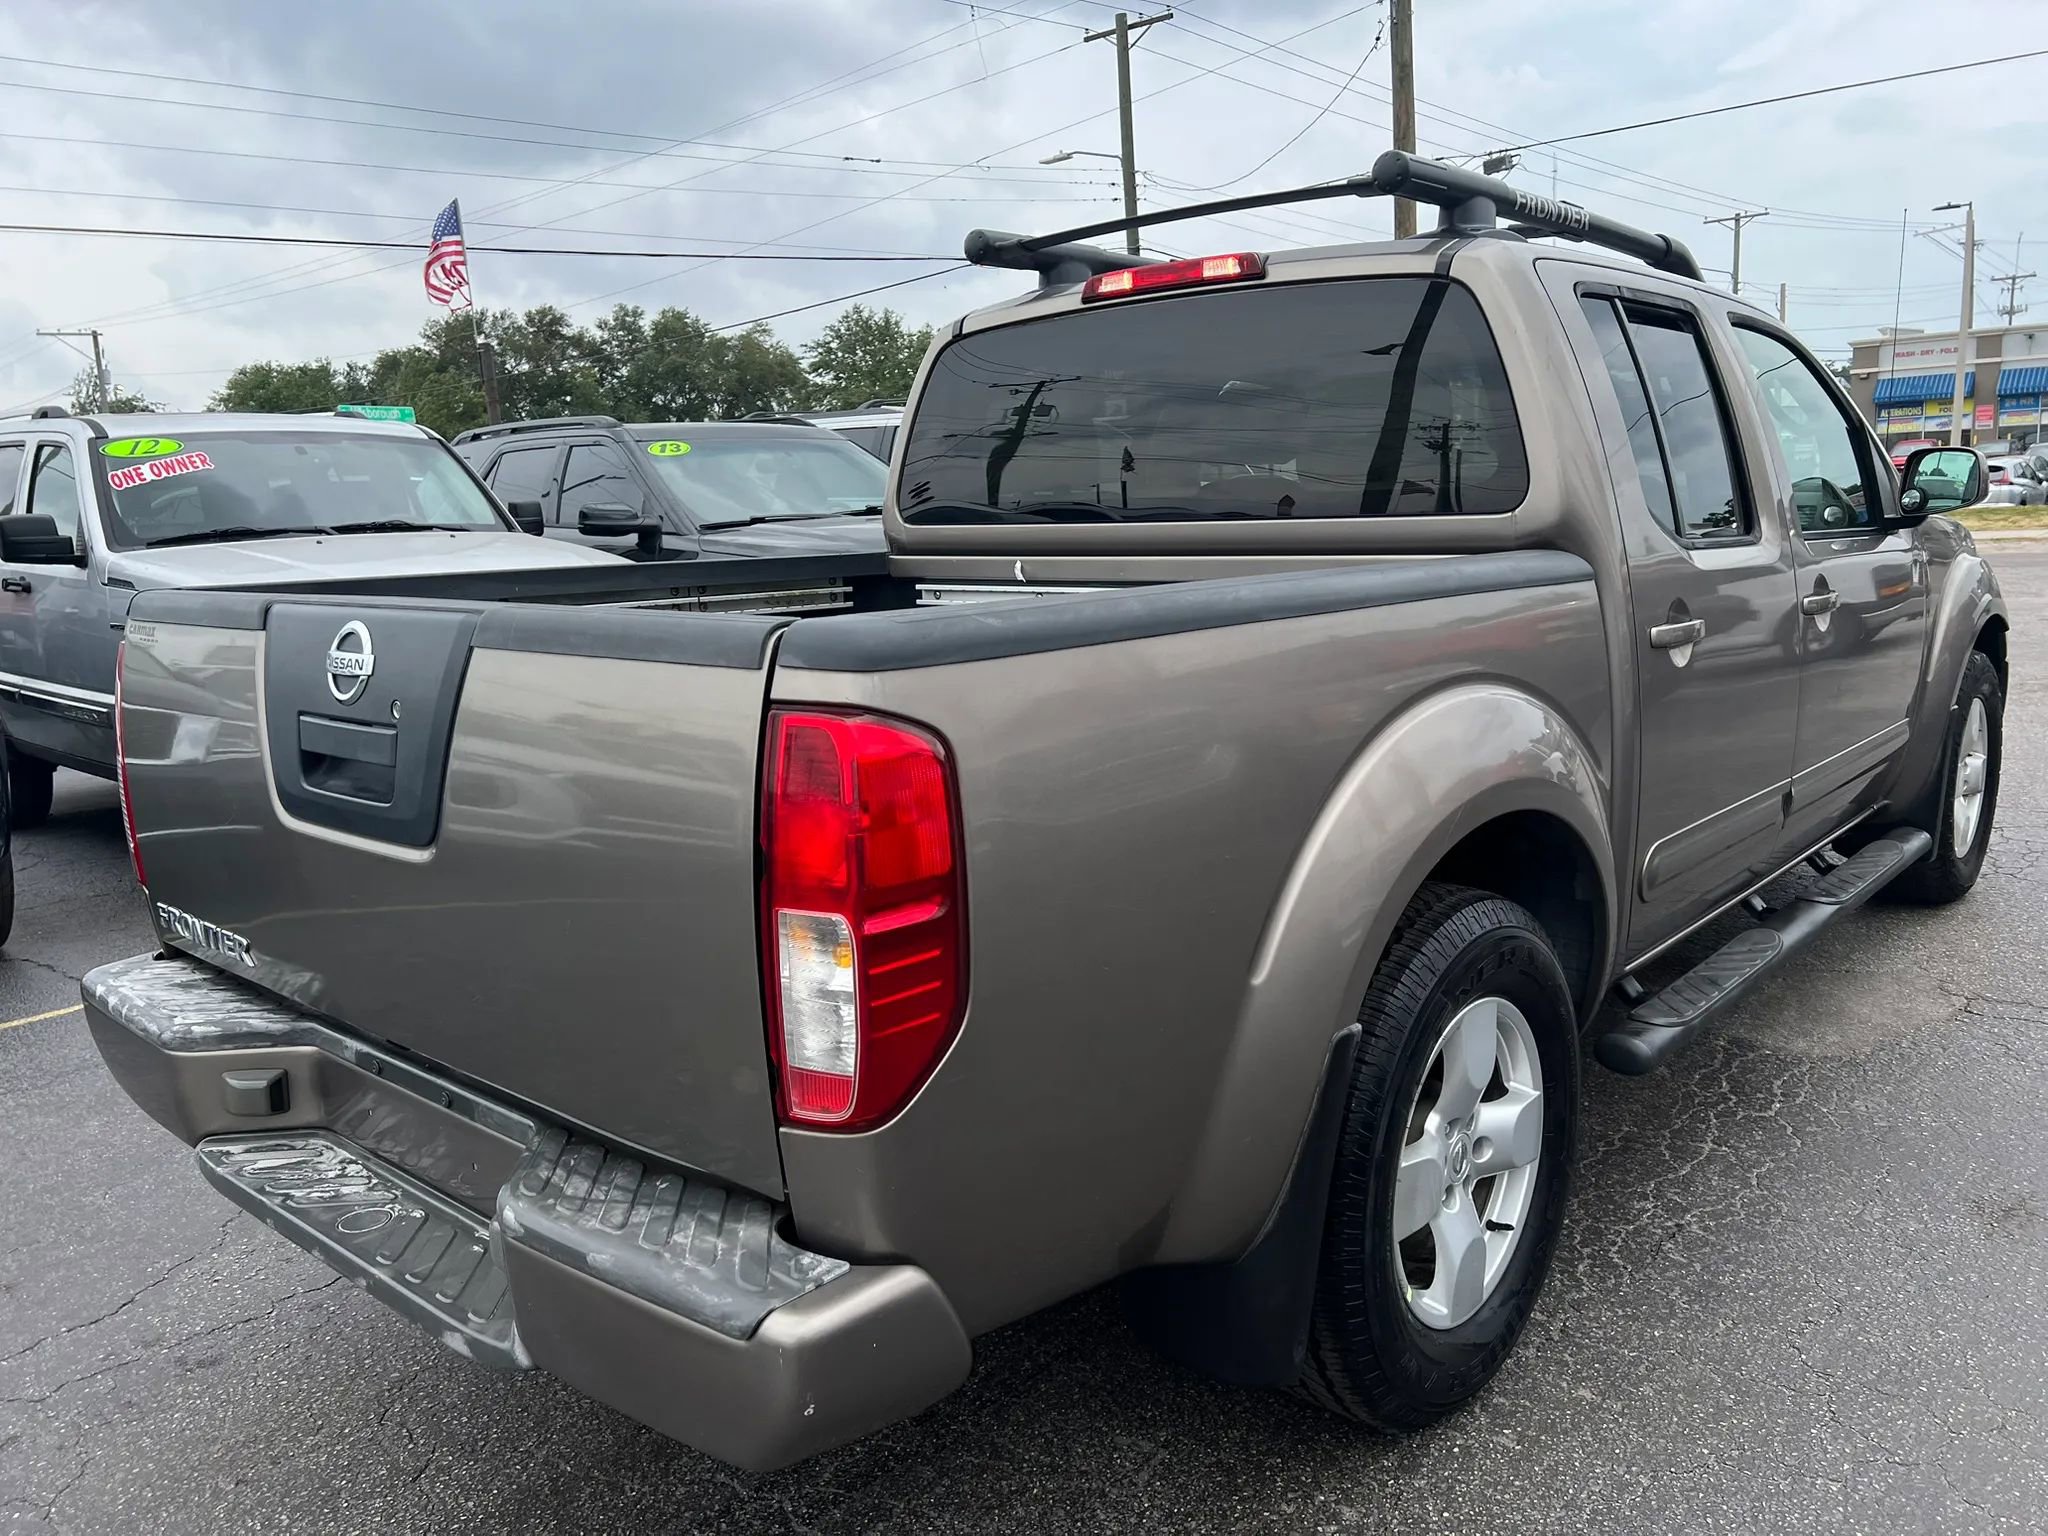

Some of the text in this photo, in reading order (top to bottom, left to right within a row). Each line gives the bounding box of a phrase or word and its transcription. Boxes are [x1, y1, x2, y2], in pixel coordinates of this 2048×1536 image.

[1514, 191, 1591, 231] FRONTIER
[1880, 406, 1922, 417] ALERATIONS
[127, 439, 160, 456] 12
[658, 443, 682, 454] 13
[110, 453, 213, 489] ONE OWNER
[327, 653, 365, 671] NISSAN
[156, 901, 255, 968] FRONTIER
